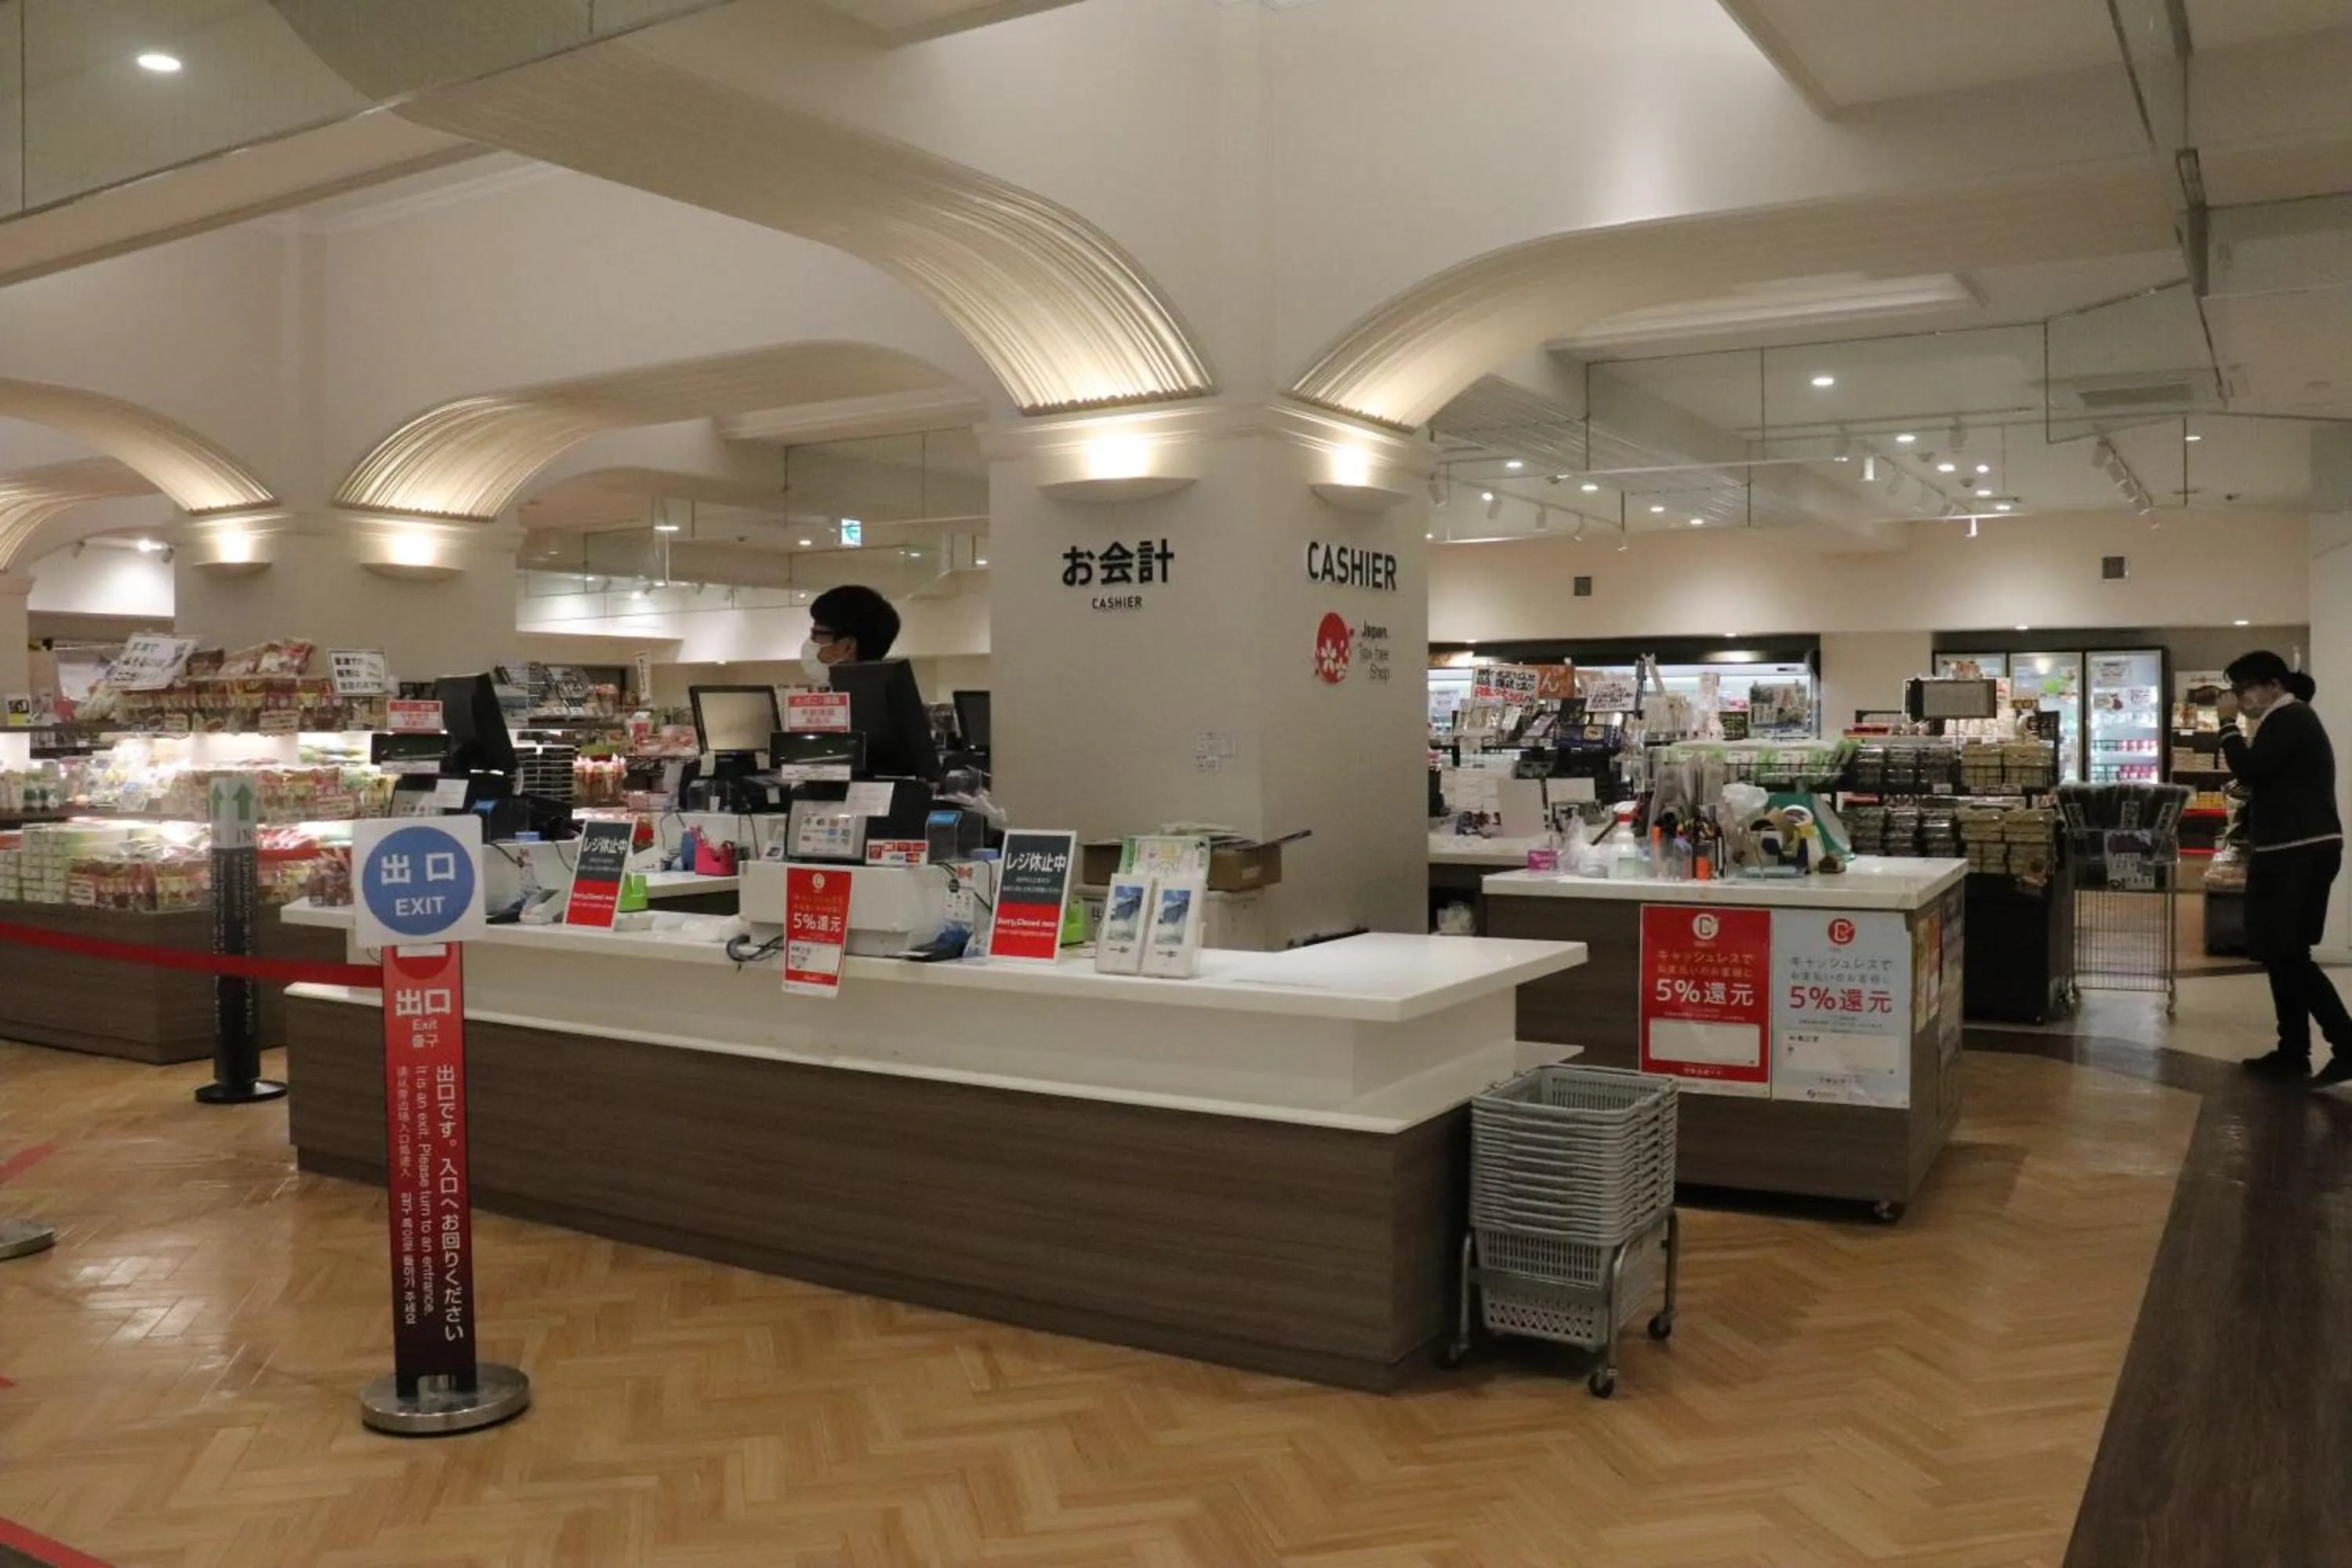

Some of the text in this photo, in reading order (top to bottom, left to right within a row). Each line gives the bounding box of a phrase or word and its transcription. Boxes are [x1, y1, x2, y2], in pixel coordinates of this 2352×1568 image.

[1062, 539, 1174, 586] お会計
[1307, 541, 1397, 591] CASHIER
[1092, 595, 1142, 610] CASHIER
[583, 837, 627, 854] レジ休止中
[380, 852, 456, 885] 出口
[1006, 852, 1067, 873] レジ休止中
[395, 896, 444, 917] EXIT
[793, 912, 841, 933] 5%還元
[1655, 978, 1754, 1006] 5%還元
[1789, 985, 1893, 1014] 5%還元
[396, 989, 451, 1017] 出口
[412, 1019, 437, 1031] Exit
[415, 1065, 427, 1075] It
[416, 1078, 426, 1089] is
[416, 1092, 427, 1109] an
[418, 1143, 432, 1187] Please
[419, 1190, 433, 1217] turn
[421, 1220, 433, 1233] to
[421, 1236, 432, 1253] an
